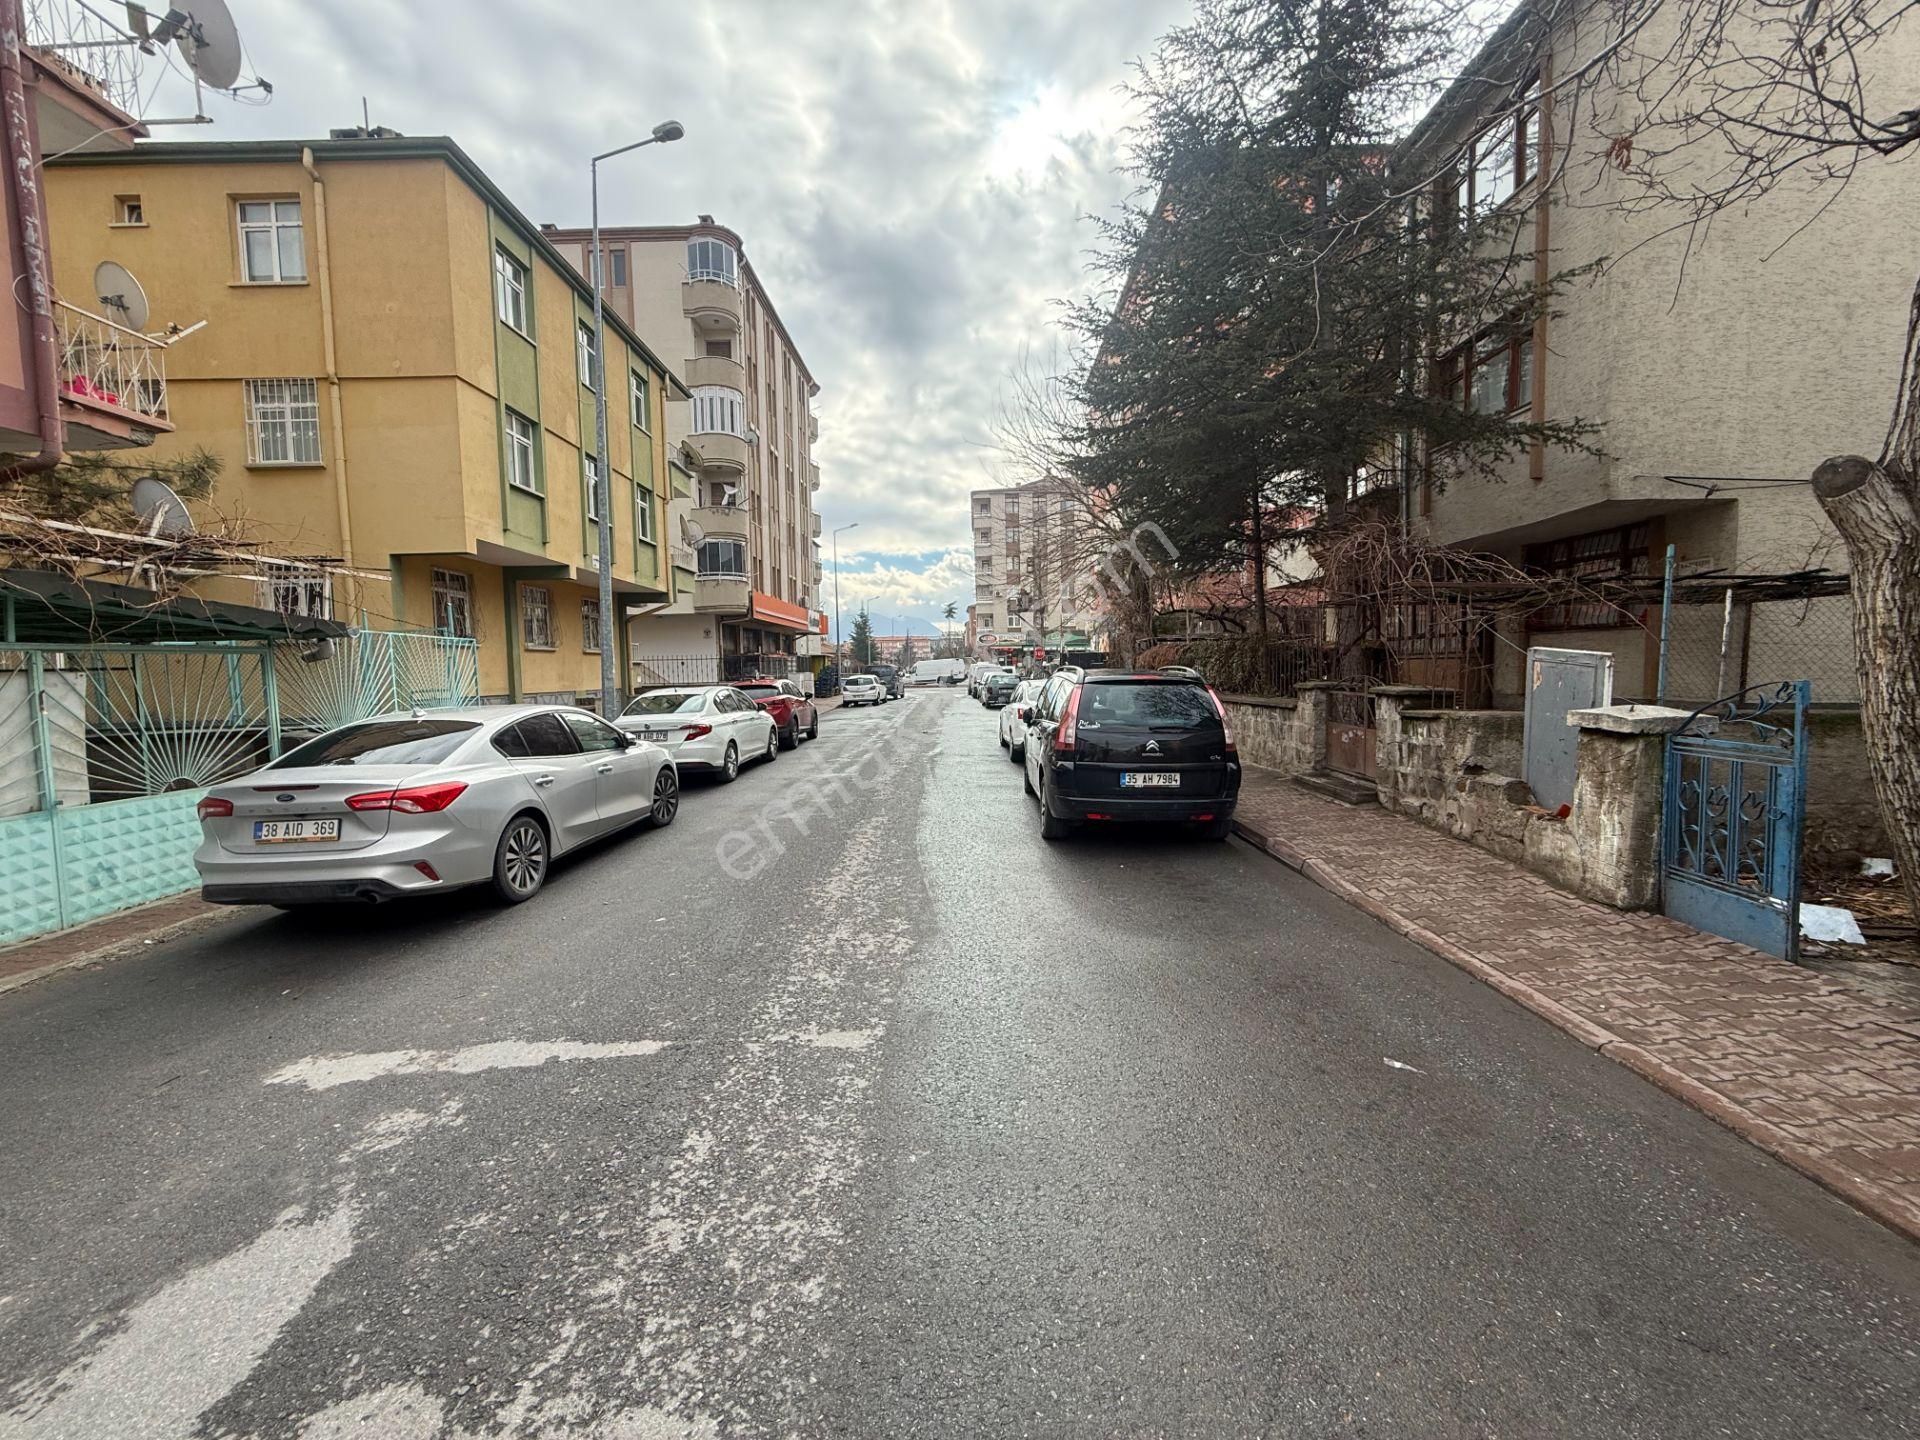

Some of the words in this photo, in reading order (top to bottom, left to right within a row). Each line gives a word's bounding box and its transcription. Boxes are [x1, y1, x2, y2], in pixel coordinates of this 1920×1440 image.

[1126, 774, 1137, 784] 35
[1142, 774, 1153, 784] AH
[1156, 774, 1178, 784] 7984
[264, 824, 278, 837] 38
[283, 823, 303, 836] AID
[312, 821, 335, 835] 369
